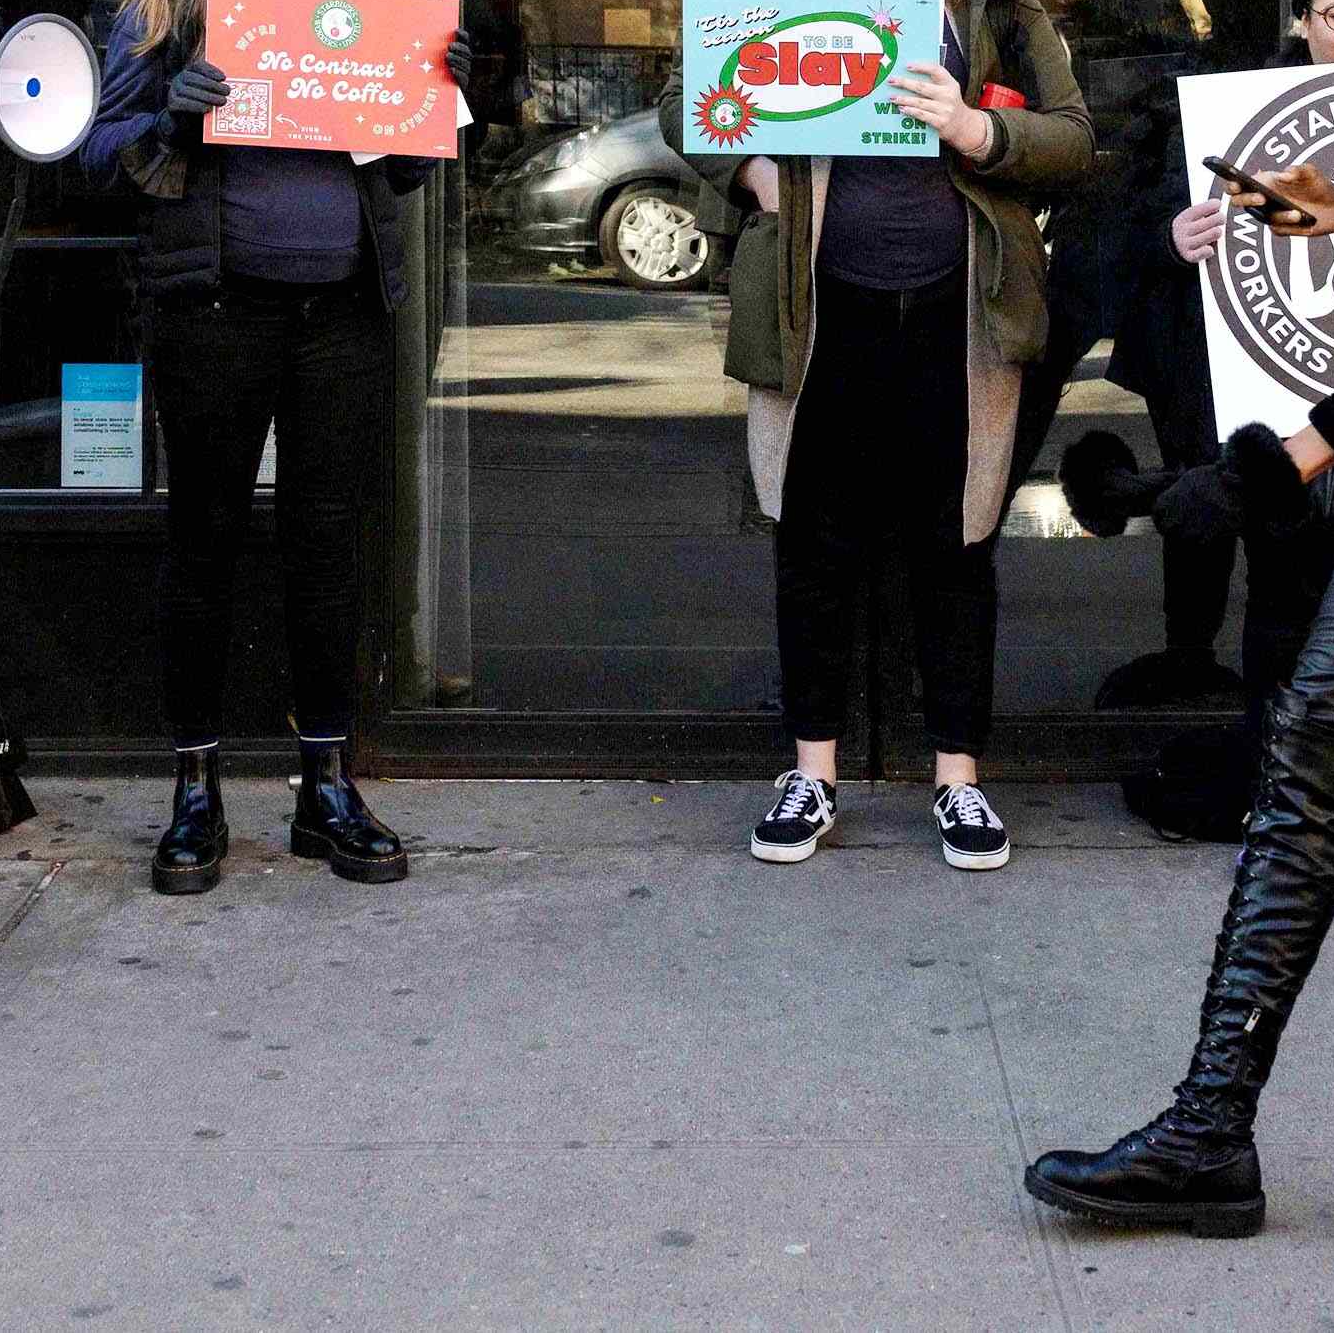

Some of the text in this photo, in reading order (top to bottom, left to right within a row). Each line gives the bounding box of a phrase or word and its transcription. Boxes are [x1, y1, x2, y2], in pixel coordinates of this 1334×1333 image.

[803, 35, 854, 48] TO BE
[257, 50, 395, 79] No Contract
[737, 41, 884, 98] Slay
[287, 77, 405, 105] No Coffee
[861, 131, 927, 145] STRIKE!
[1231, 212, 1333, 374] WORKERS
